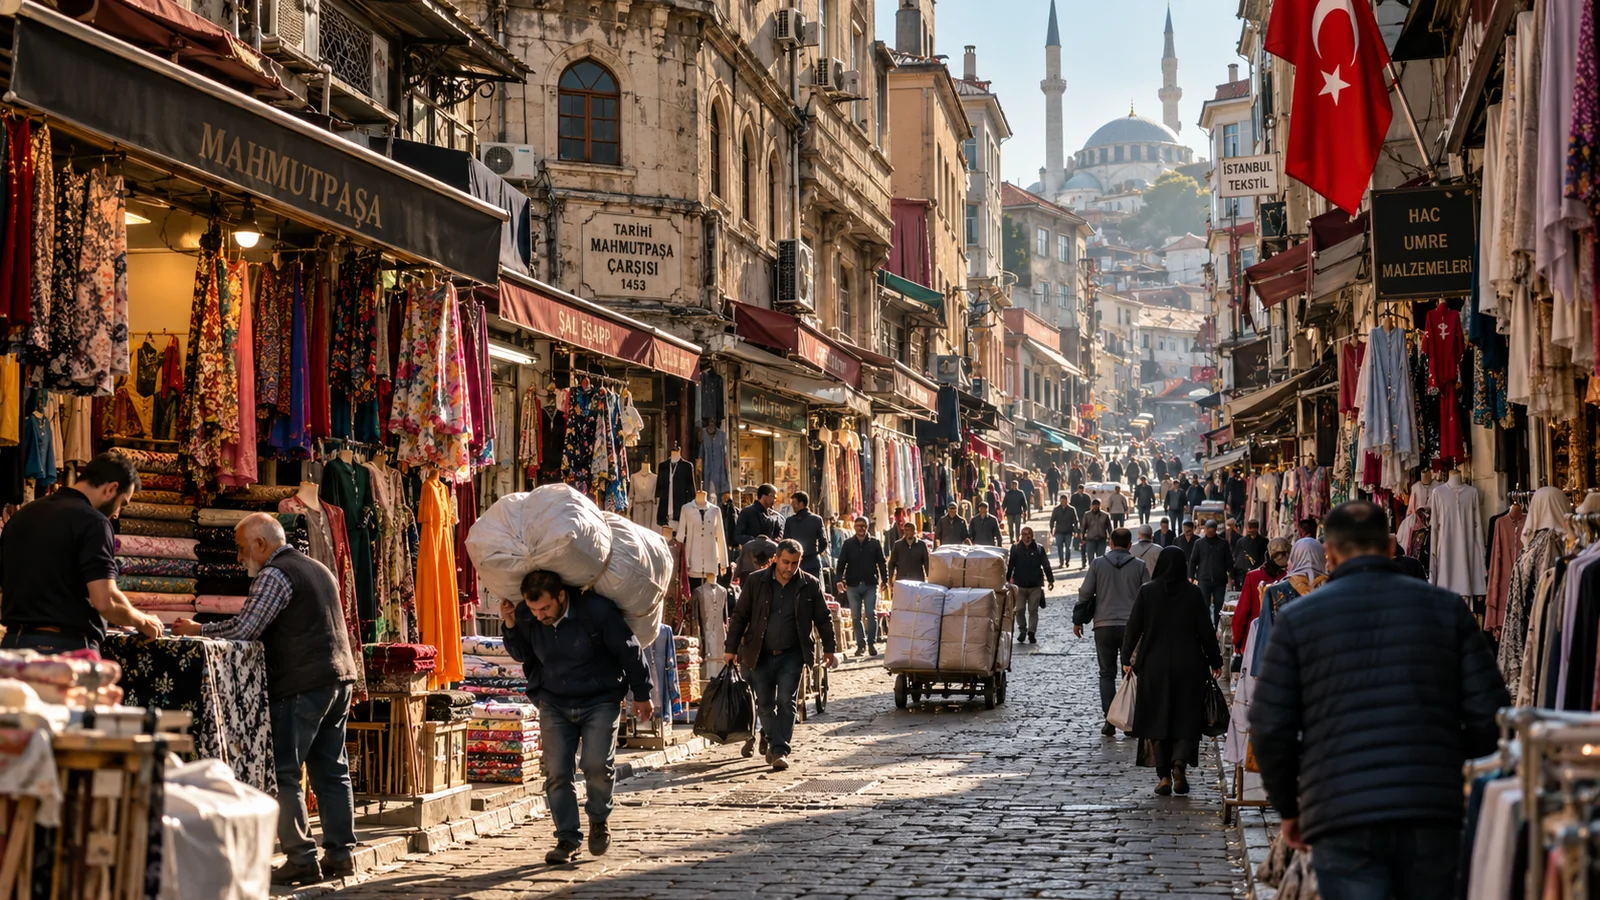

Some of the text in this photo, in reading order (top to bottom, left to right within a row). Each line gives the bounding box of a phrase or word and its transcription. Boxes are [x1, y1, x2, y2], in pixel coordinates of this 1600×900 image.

[198, 122, 383, 229] MAHMUTPAŞA
[1223, 161, 1273, 175] İSTANBUL
[1228, 176, 1269, 191] TEKSTİL
[1409, 207, 1441, 223] HAC
[613, 222, 653, 238] TARİHİ
[590, 238, 674, 260] MAHMUTPAŞA
[1404, 233, 1448, 251] UMRE
[607, 258, 659, 277] ÇARŞISI
[1382, 256, 1472, 278] MALZEMELERİ
[621, 278, 646, 291] 1453
[558, 310, 578, 335] ŞAL
